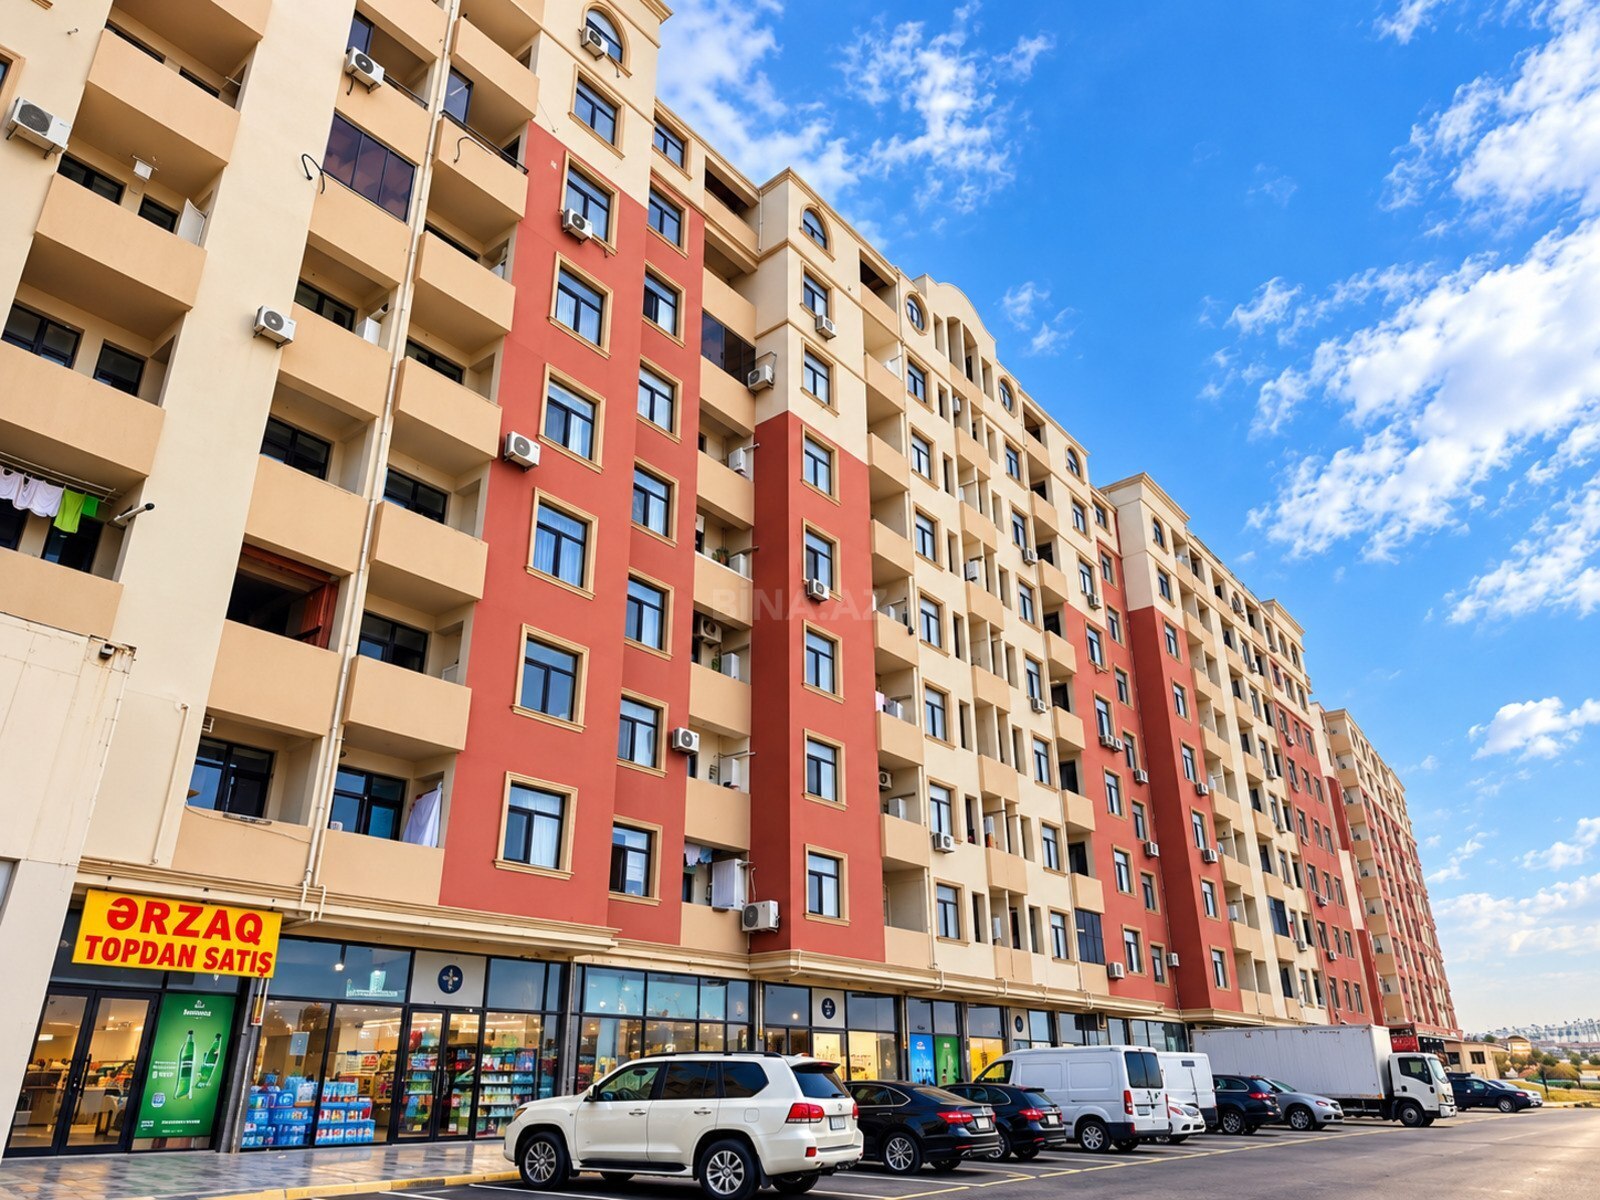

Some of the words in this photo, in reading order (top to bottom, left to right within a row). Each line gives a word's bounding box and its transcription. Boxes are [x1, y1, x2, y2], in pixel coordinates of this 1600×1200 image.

[106, 897, 263, 946] ƏRZAQ
[85, 935, 198, 968] TOPDAN
[202, 946, 273, 977] SATIŞ
